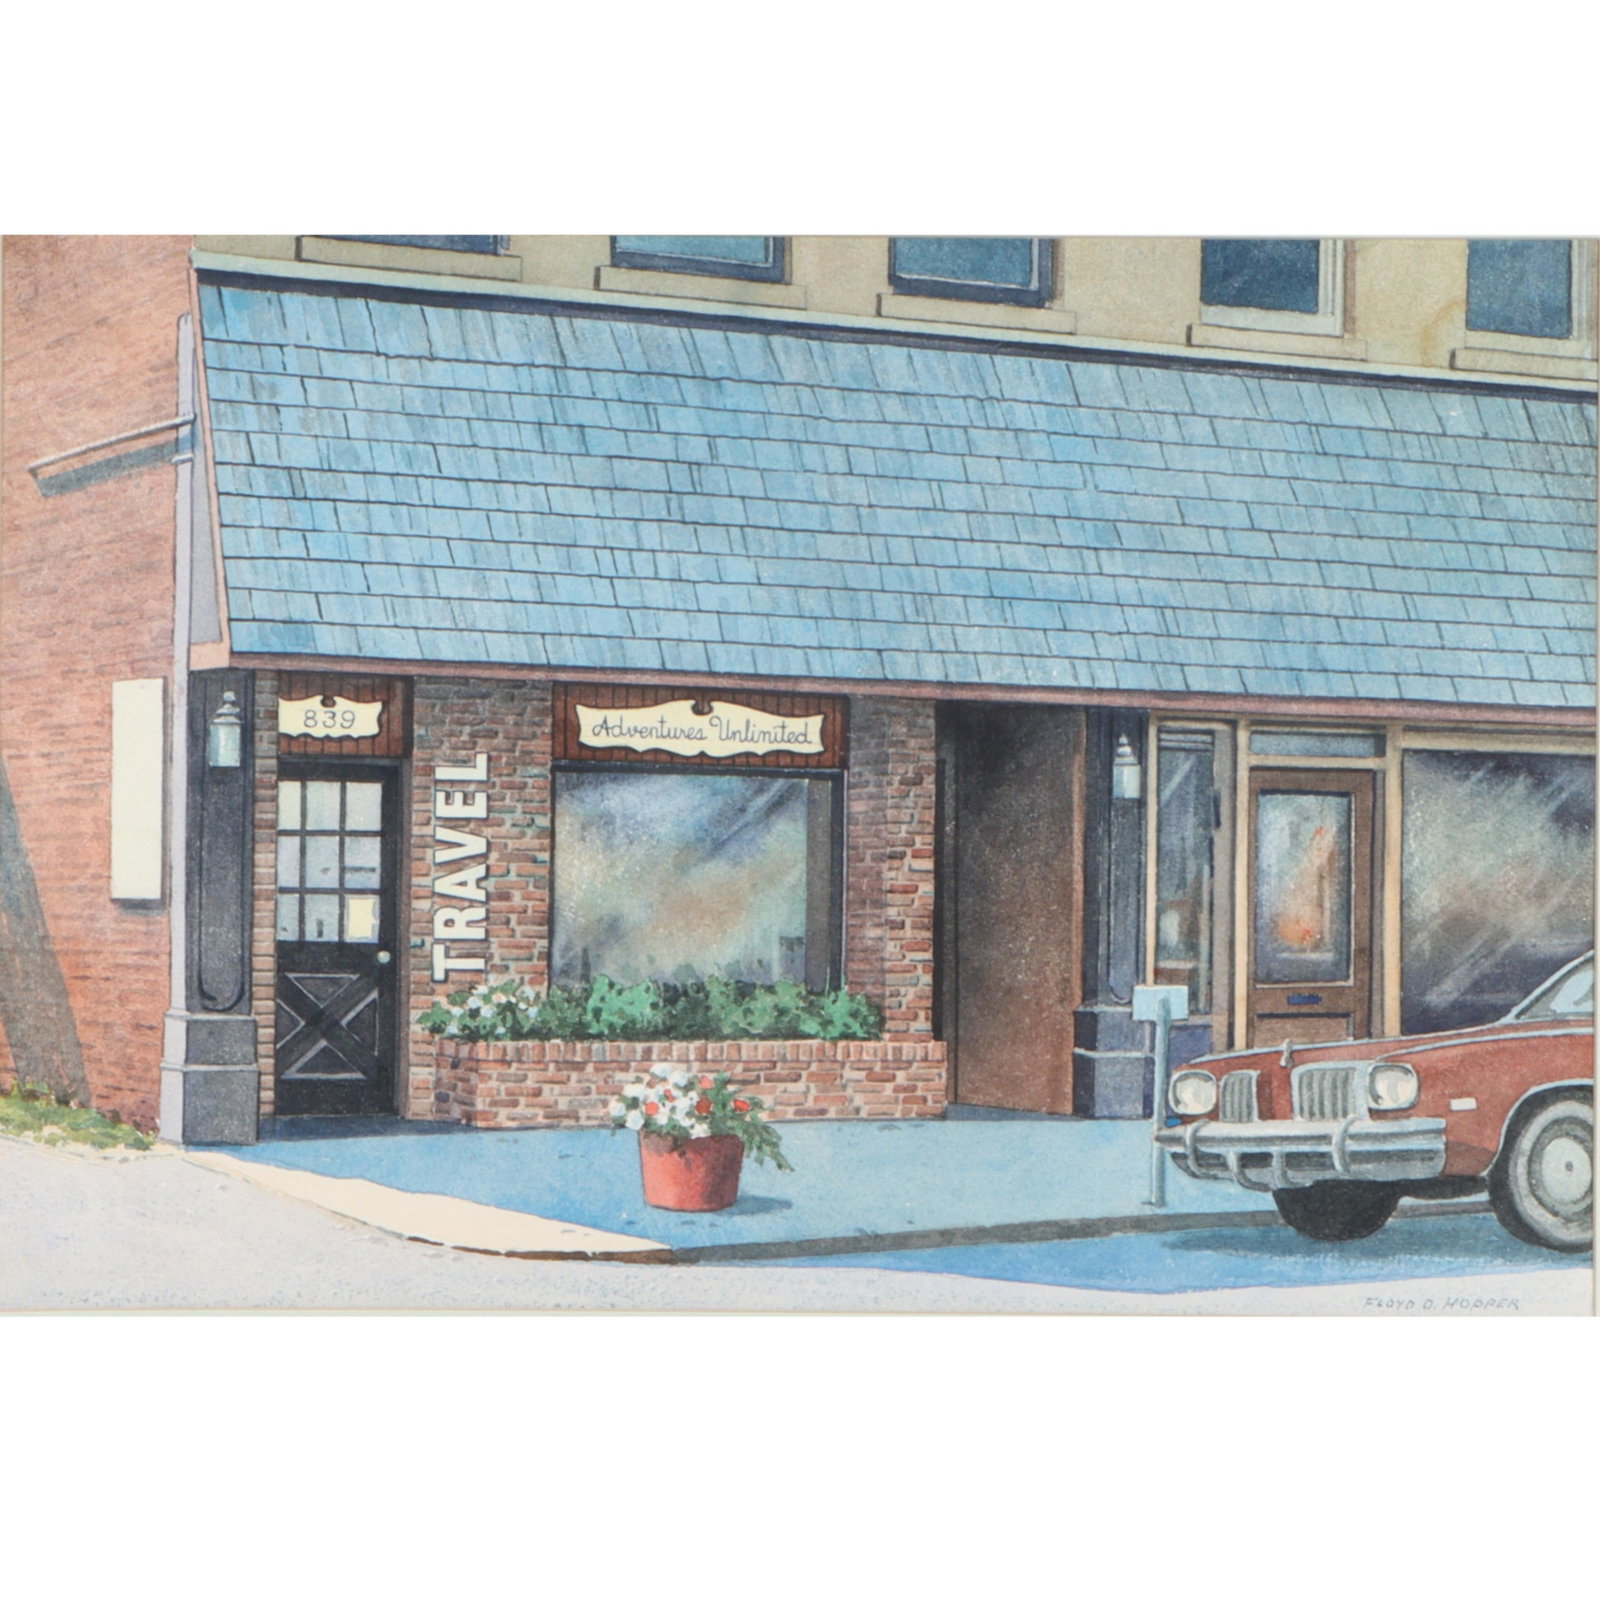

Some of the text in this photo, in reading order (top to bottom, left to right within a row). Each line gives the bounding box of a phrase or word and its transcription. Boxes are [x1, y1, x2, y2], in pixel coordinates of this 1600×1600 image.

[303, 709, 356, 730] 839
[592, 714, 813, 744] Adventures Unlimited
[431, 751, 489, 983] TRAVEL
[1363, 1295, 1521, 1311] FLOYD D. HOPPER
